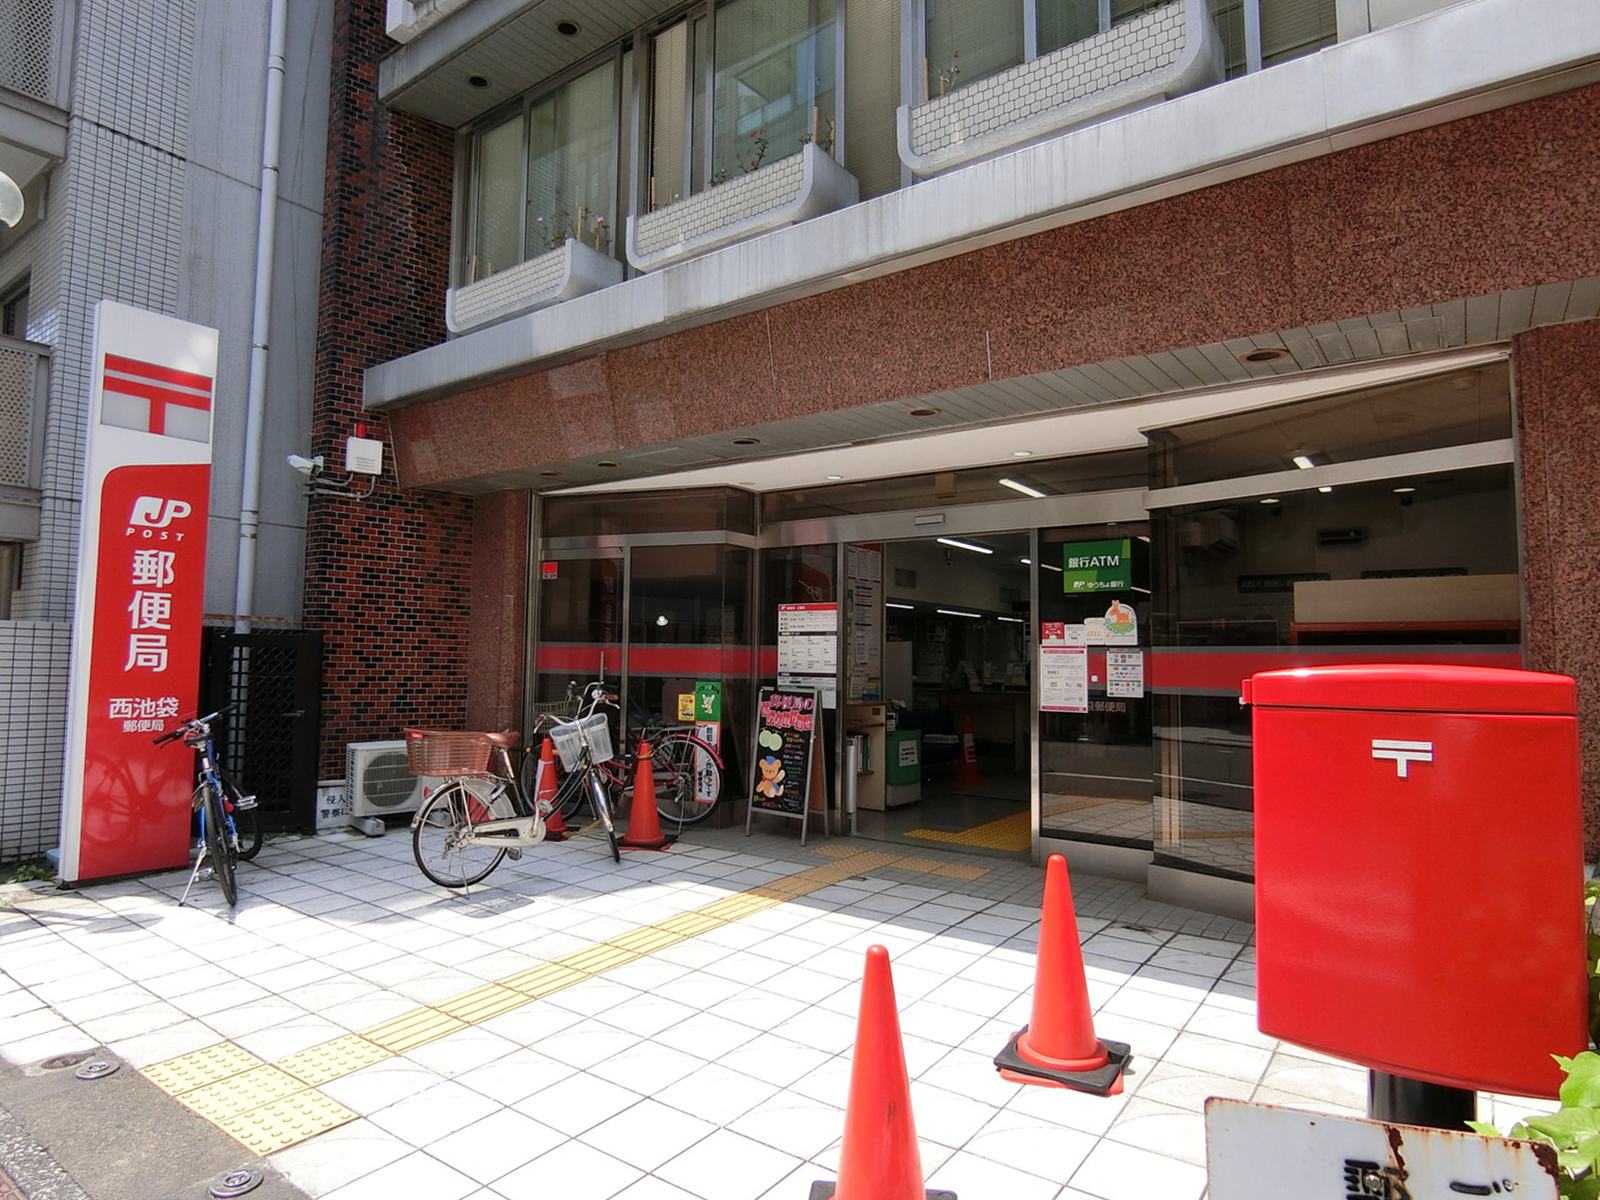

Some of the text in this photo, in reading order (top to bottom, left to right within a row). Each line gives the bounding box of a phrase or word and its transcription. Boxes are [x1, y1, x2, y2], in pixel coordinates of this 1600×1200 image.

[130, 496, 191, 528] JP
[126, 527, 185, 541] POST
[1068, 555, 1119, 568] 銀行ATM
[1087, 580, 1124, 589] ゆうちょ銀行
[124, 550, 175, 672] 郵便局
[109, 697, 179, 719] 西池袋
[122, 719, 164, 733] 郵便局
[326, 794, 346, 805] 侵入
